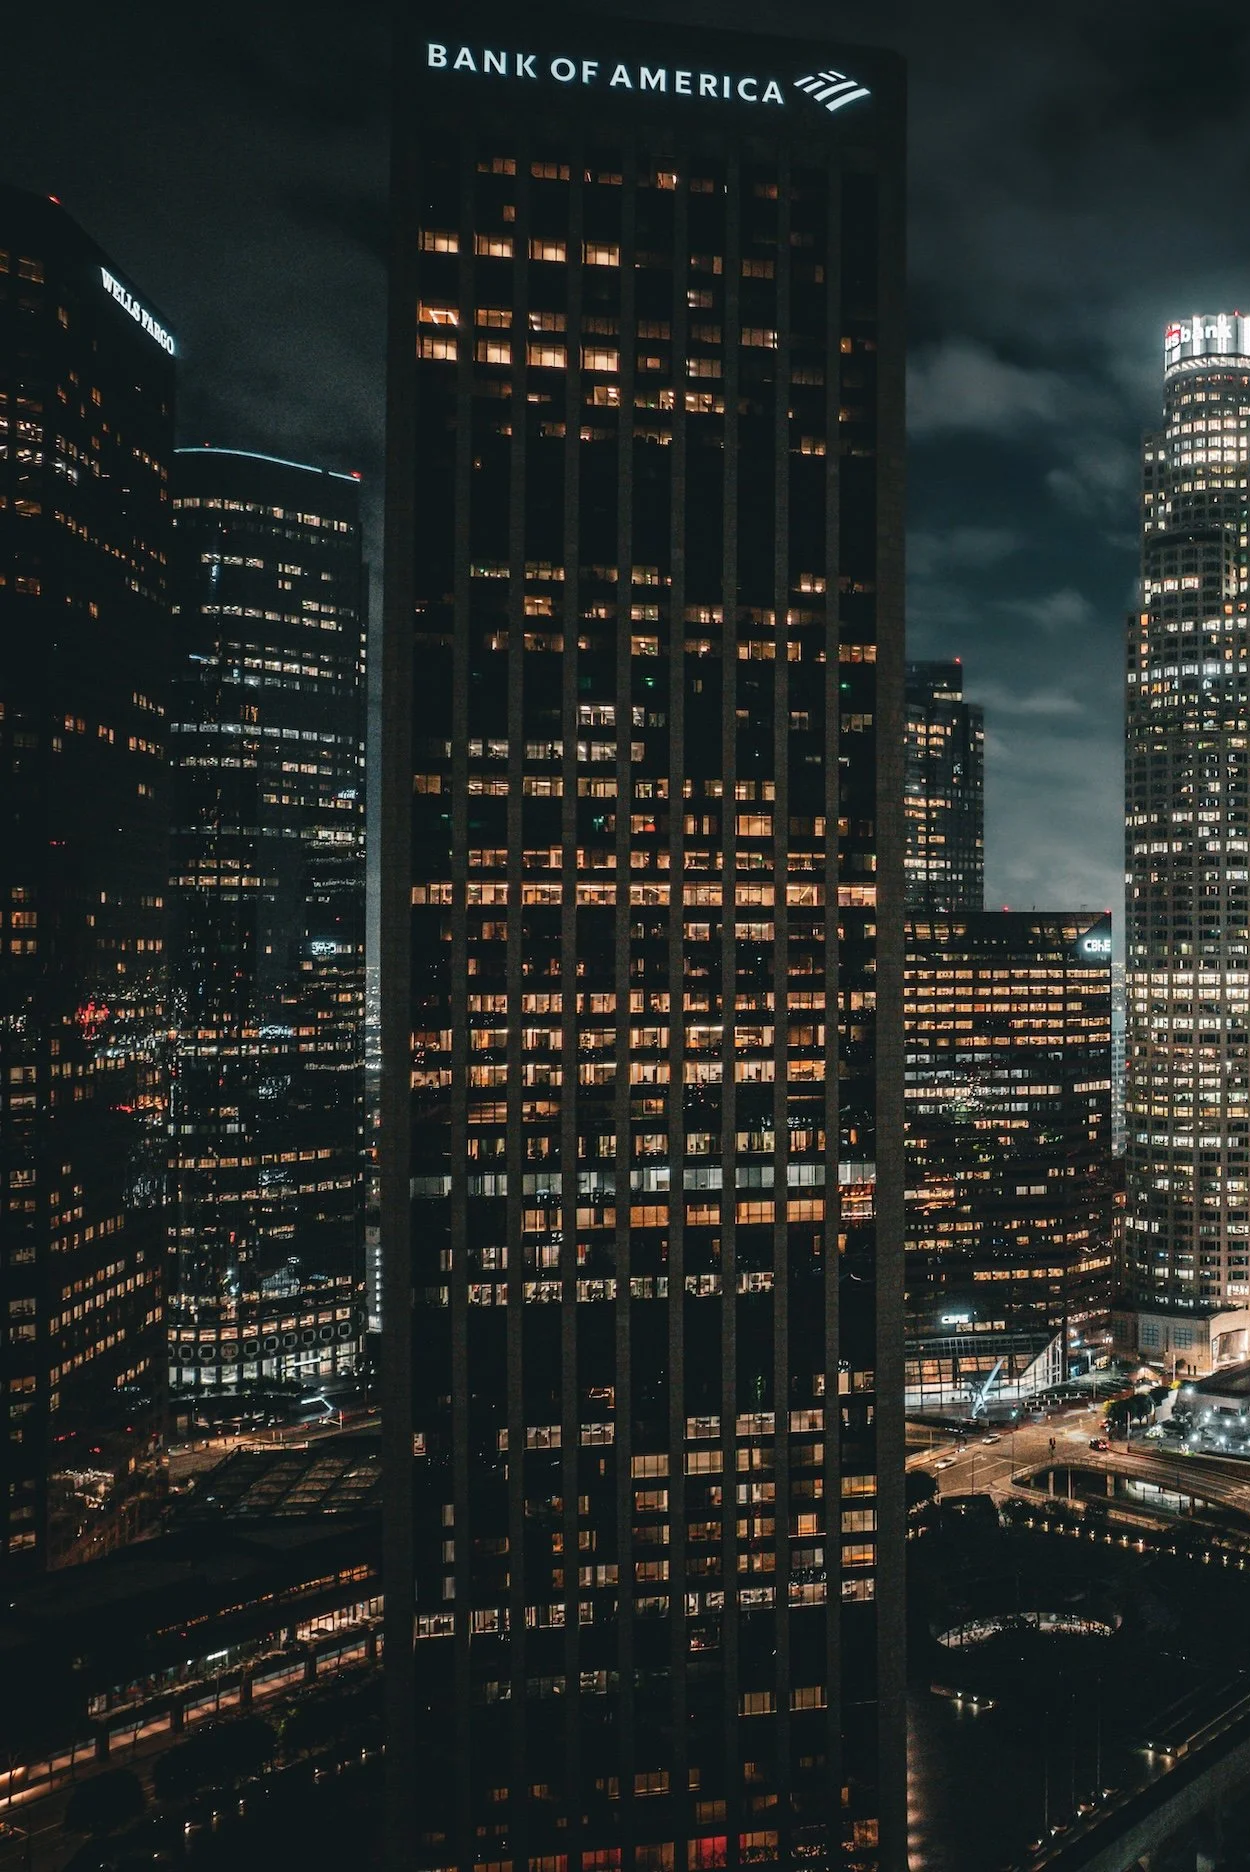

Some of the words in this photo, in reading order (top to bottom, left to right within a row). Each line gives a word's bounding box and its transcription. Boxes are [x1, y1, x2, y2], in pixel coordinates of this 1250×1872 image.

[427, 43, 537, 79] BANK
[550, 57, 599, 84] OF
[609, 64, 785, 105] AMERICA
[100, 266, 141, 322] WELLS
[141, 308, 175, 356] FARGO
